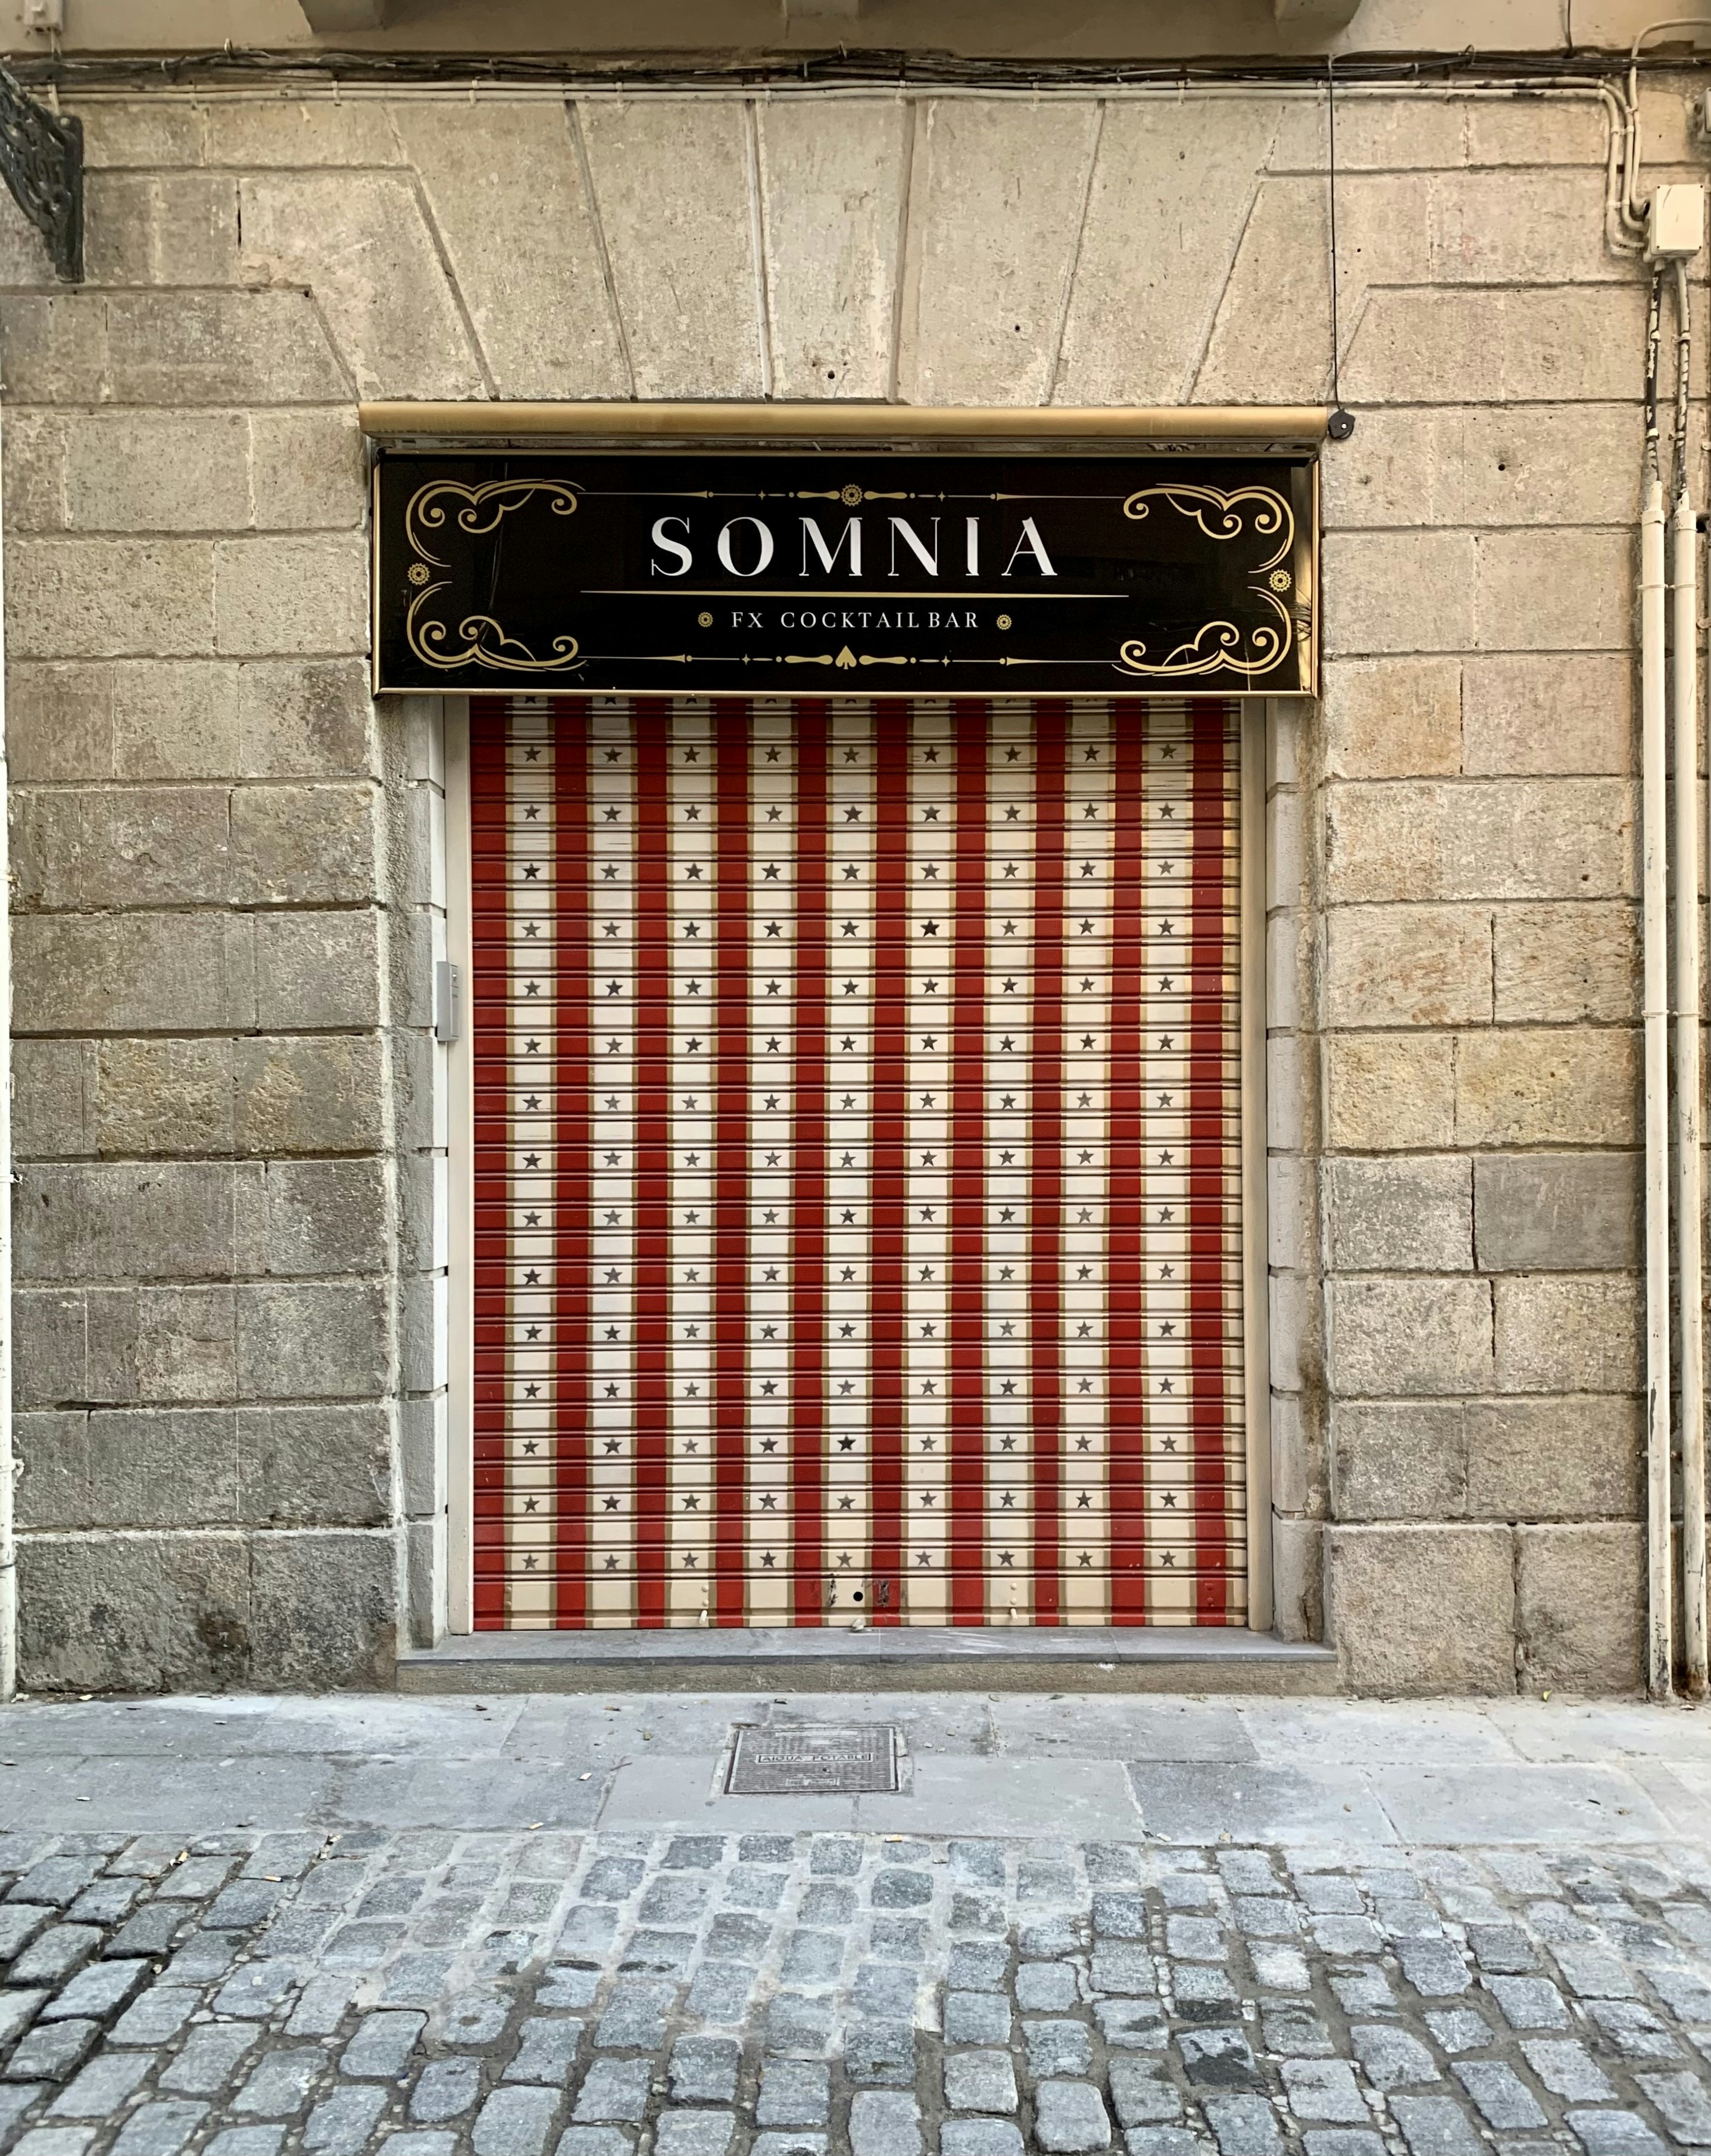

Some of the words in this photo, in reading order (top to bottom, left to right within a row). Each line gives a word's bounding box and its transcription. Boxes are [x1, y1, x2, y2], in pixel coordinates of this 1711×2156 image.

[651, 516, 1058, 577] SOMNIA
[732, 611, 763, 628] FX
[780, 611, 920, 629] COCKTAIL
[928, 612, 979, 628] BAR
